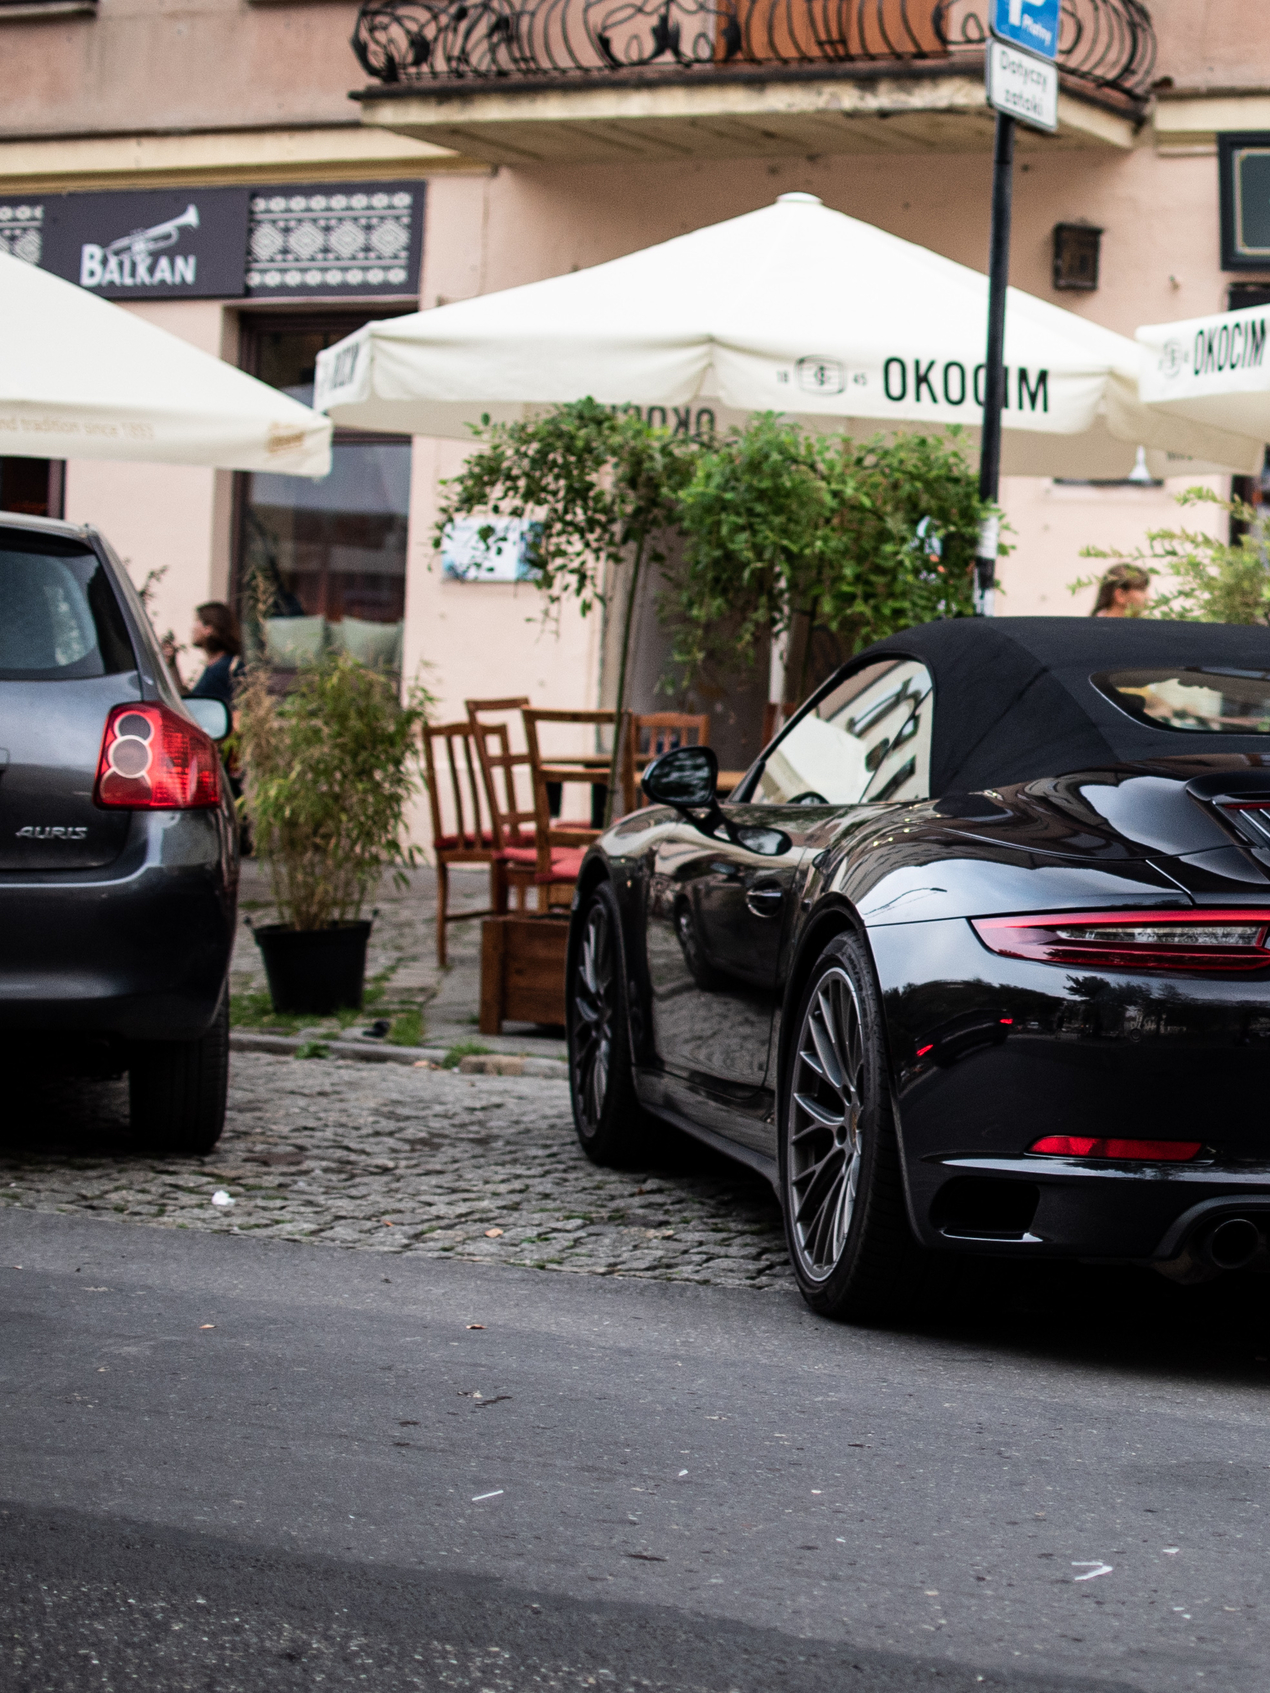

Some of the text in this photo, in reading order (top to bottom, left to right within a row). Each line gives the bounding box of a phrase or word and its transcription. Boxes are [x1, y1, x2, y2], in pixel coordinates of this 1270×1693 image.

[1001, 49, 1048, 92] Dotyczy
[80, 244, 196, 287] BALKAN
[1194, 318, 1266, 376] OKOCIM
[15, 826, 88, 839] AURIS
